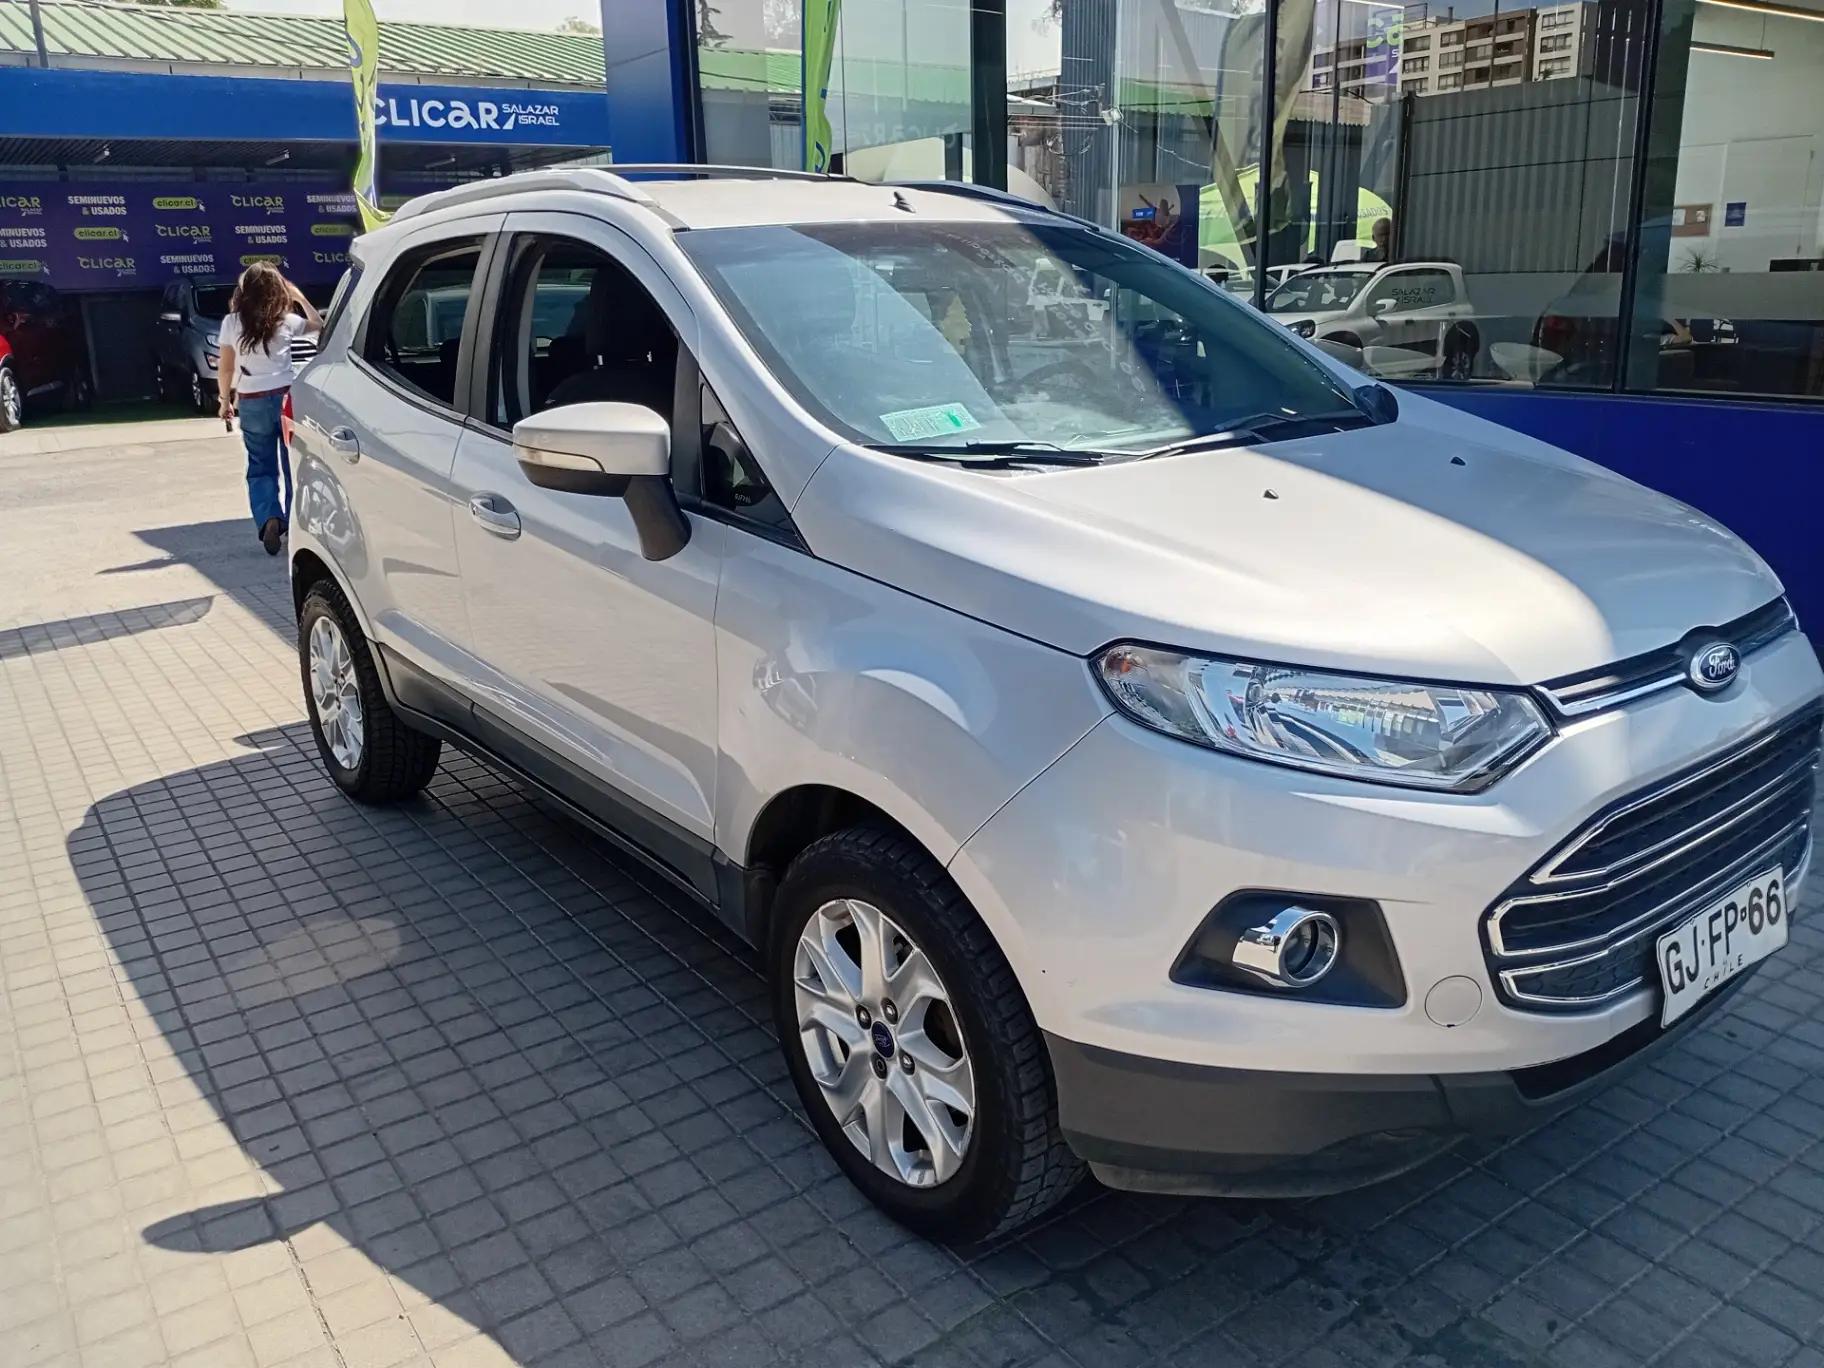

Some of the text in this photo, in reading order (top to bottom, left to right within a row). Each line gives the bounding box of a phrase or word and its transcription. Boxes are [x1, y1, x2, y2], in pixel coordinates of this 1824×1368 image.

[502, 103, 559, 115] SALAZAR
[518, 115, 560, 126] ISRAEL
[68, 195, 126, 205] SEMINUEVOS
[156, 199, 195, 207] clicar.cl
[91, 206, 127, 216] USADOS
[0, 228, 46, 237] MINUEVOS
[78, 229, 118, 238] clicar.cl
[235, 225, 286, 235] SEMINUEVOS
[9, 239, 47, 248] USADOS
[255, 235, 288, 244] USADOS
[160, 254, 215, 264] SEMINUEVOS
[181, 264, 216, 274] USADOS
[1708, 650, 1737, 678] Ford
[1704, 953, 1744, 990] CHILE
